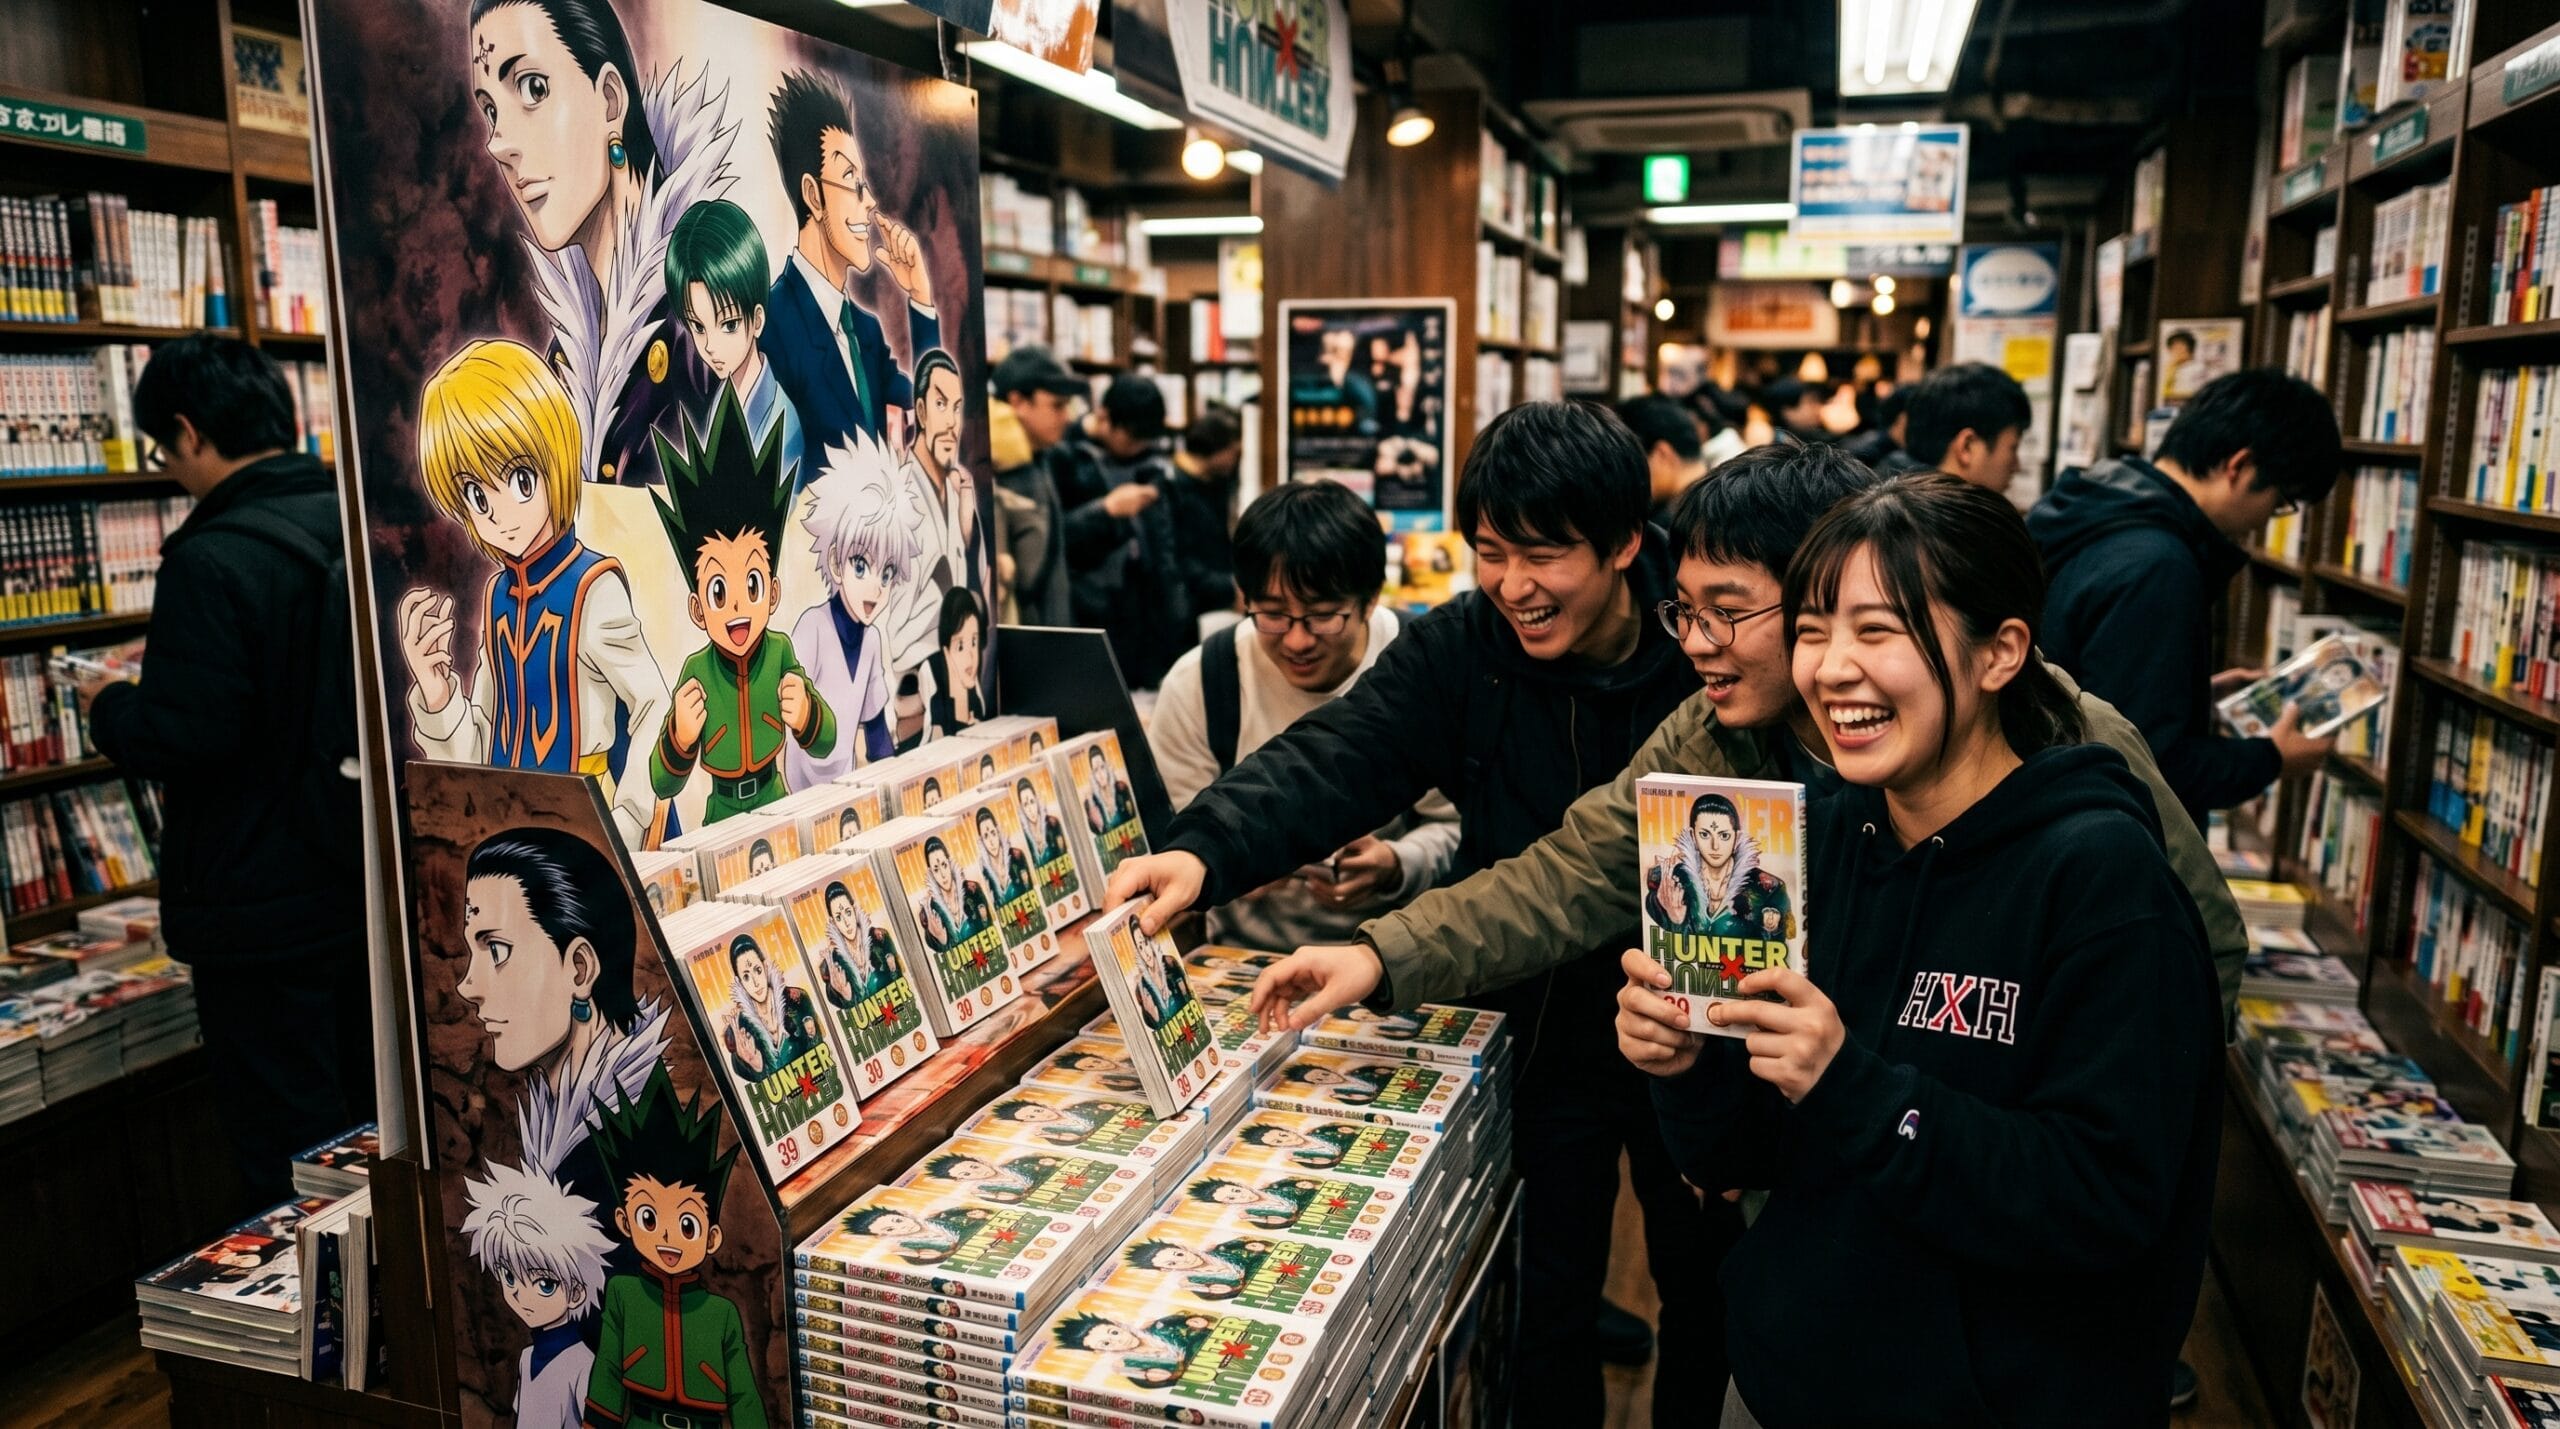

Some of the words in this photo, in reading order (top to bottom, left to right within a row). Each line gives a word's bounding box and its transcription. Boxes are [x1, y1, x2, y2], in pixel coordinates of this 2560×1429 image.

[999, 889, 1042, 928] UNTER
[933, 925, 1003, 981] HUNTER
[1650, 925, 1790, 969] HUNTER
[836, 976, 913, 1040] HUNTER
[1153, 1000, 1205, 1060] HUNTER
[1663, 995, 1690, 1016] 9
[1897, 972, 2020, 1045] HXH
[744, 1042, 836, 1115] HUNTER
[777, 1137, 800, 1168] 39
[937, 1208, 1028, 1274] HUNTER
[1231, 1240, 1306, 1308] HUNTER
[1169, 1316, 1253, 1400] HUNTER
